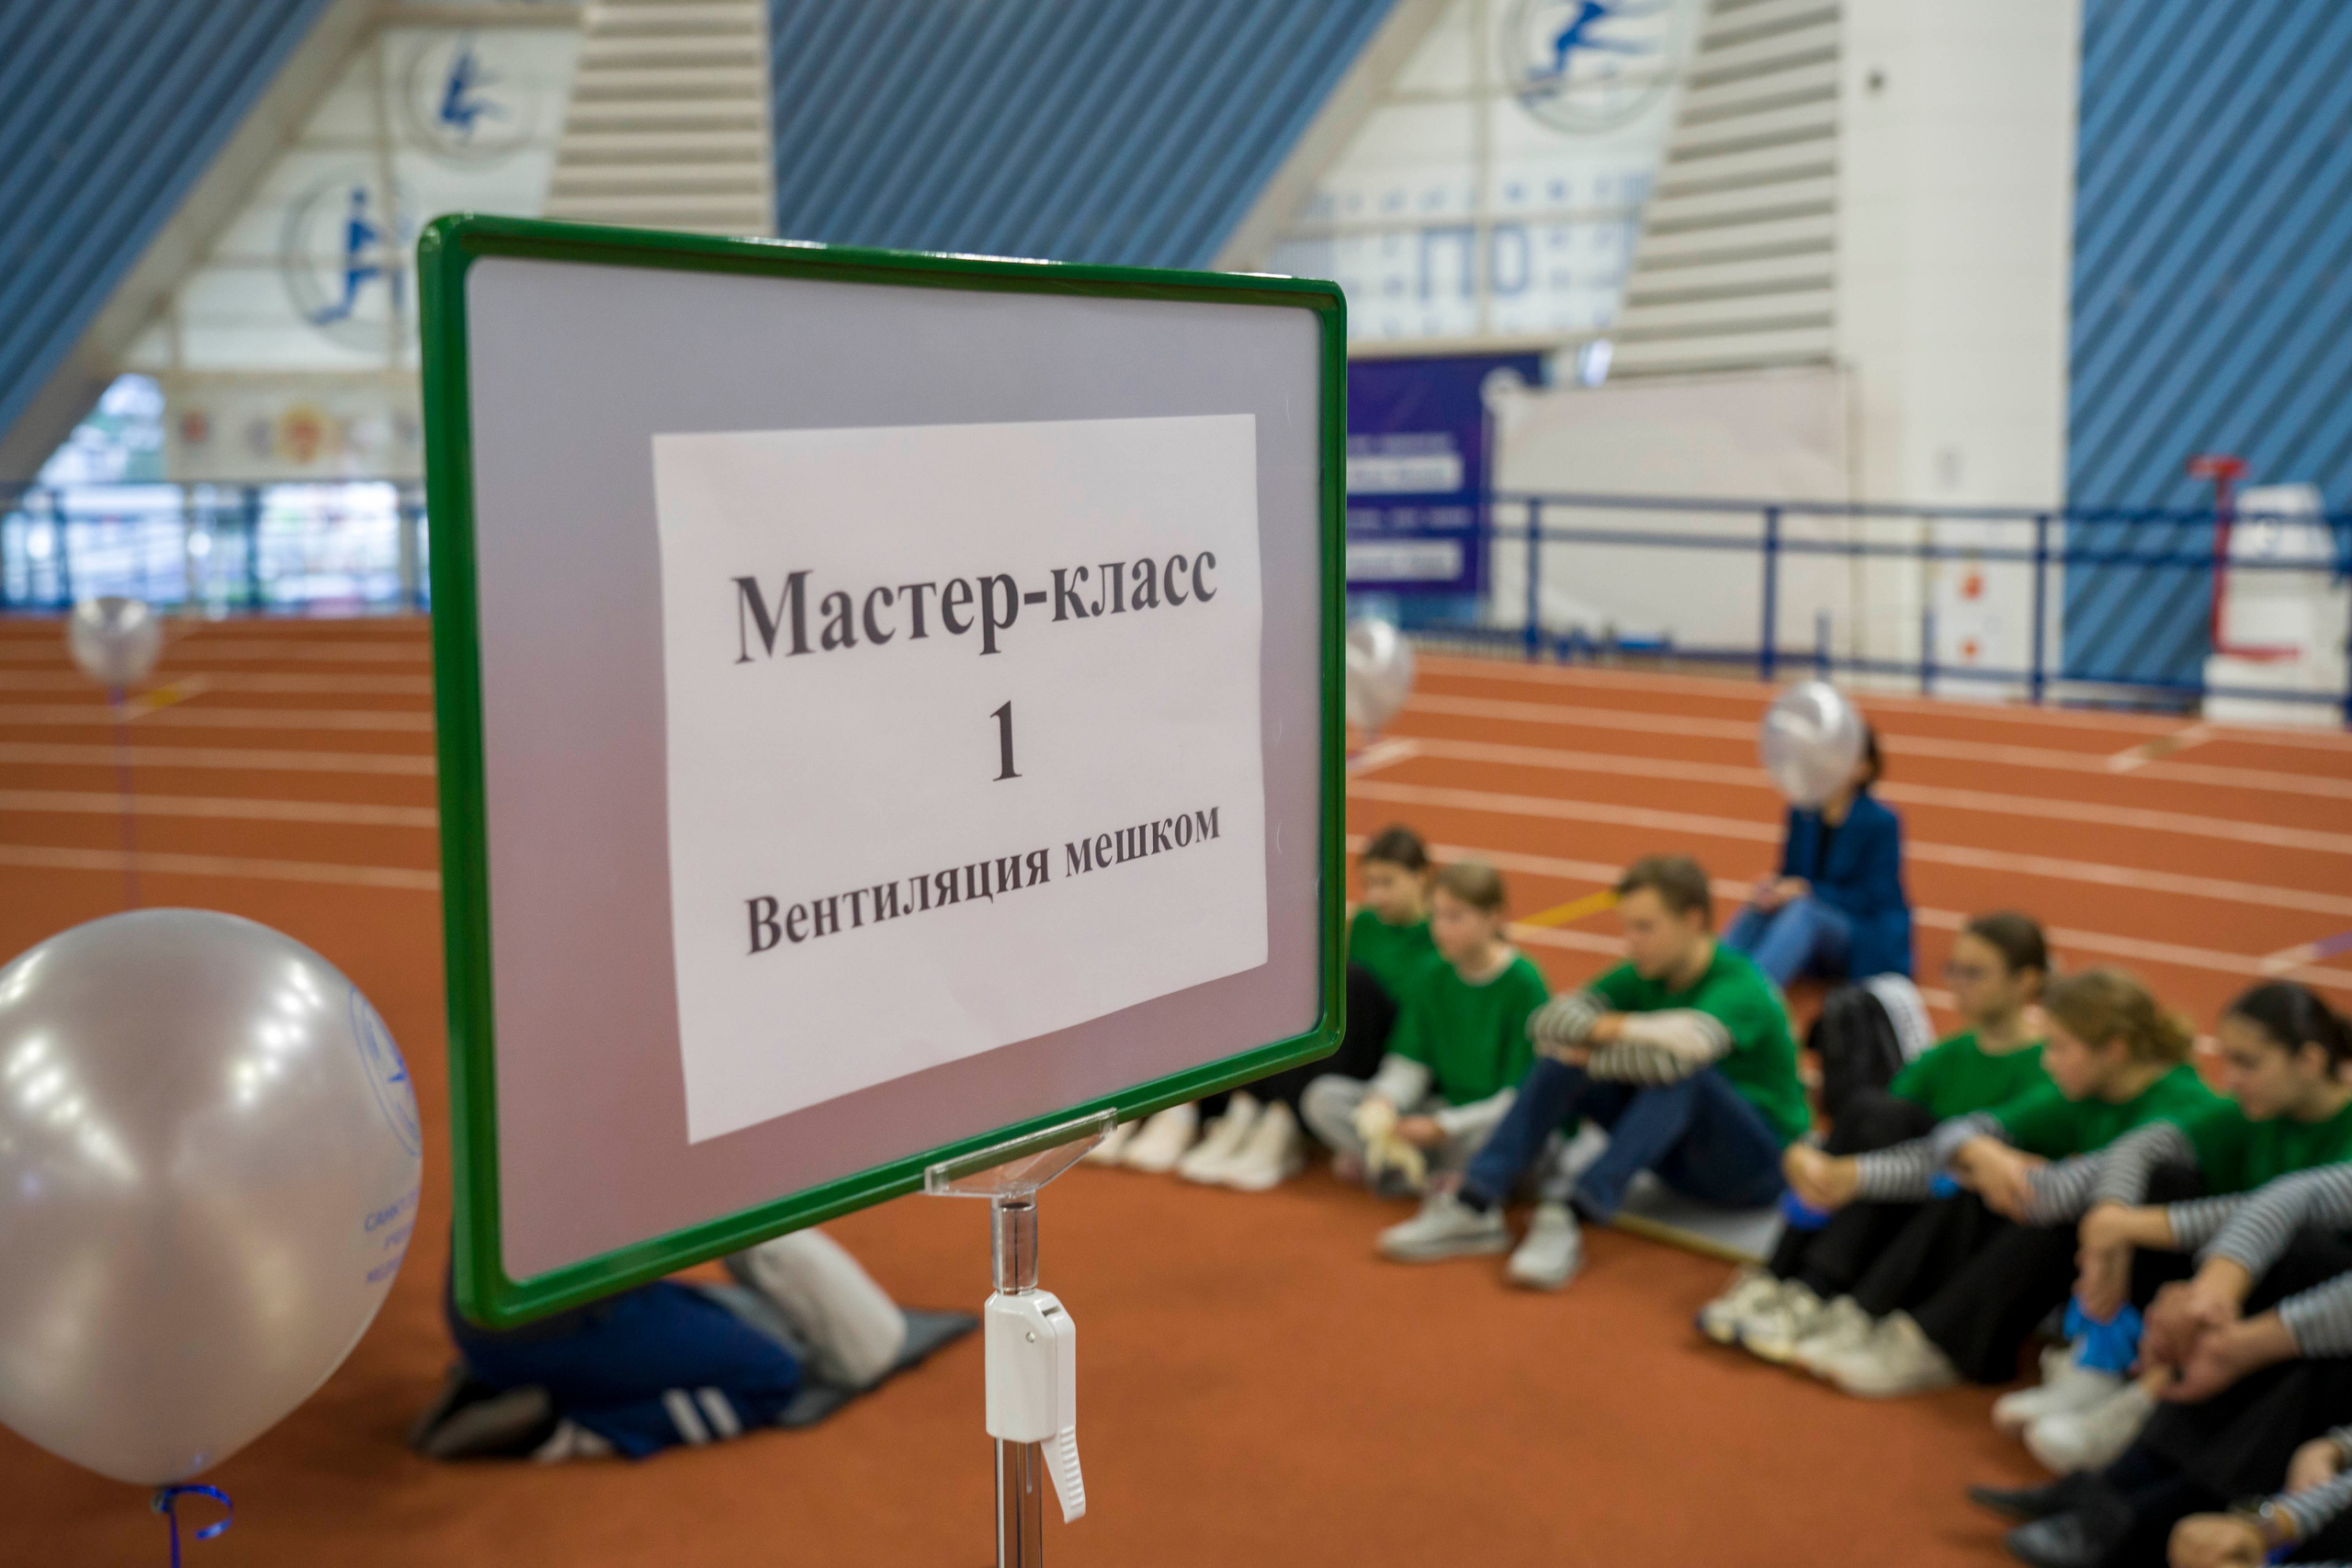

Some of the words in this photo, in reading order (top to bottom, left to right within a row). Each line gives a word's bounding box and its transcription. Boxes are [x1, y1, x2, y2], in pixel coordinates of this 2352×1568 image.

[731, 551, 1218, 665] Мастер-класс
[989, 699, 1023, 783] 1
[745, 847, 1053, 956] Вентиляция
[1065, 806, 1222, 879] мешком
